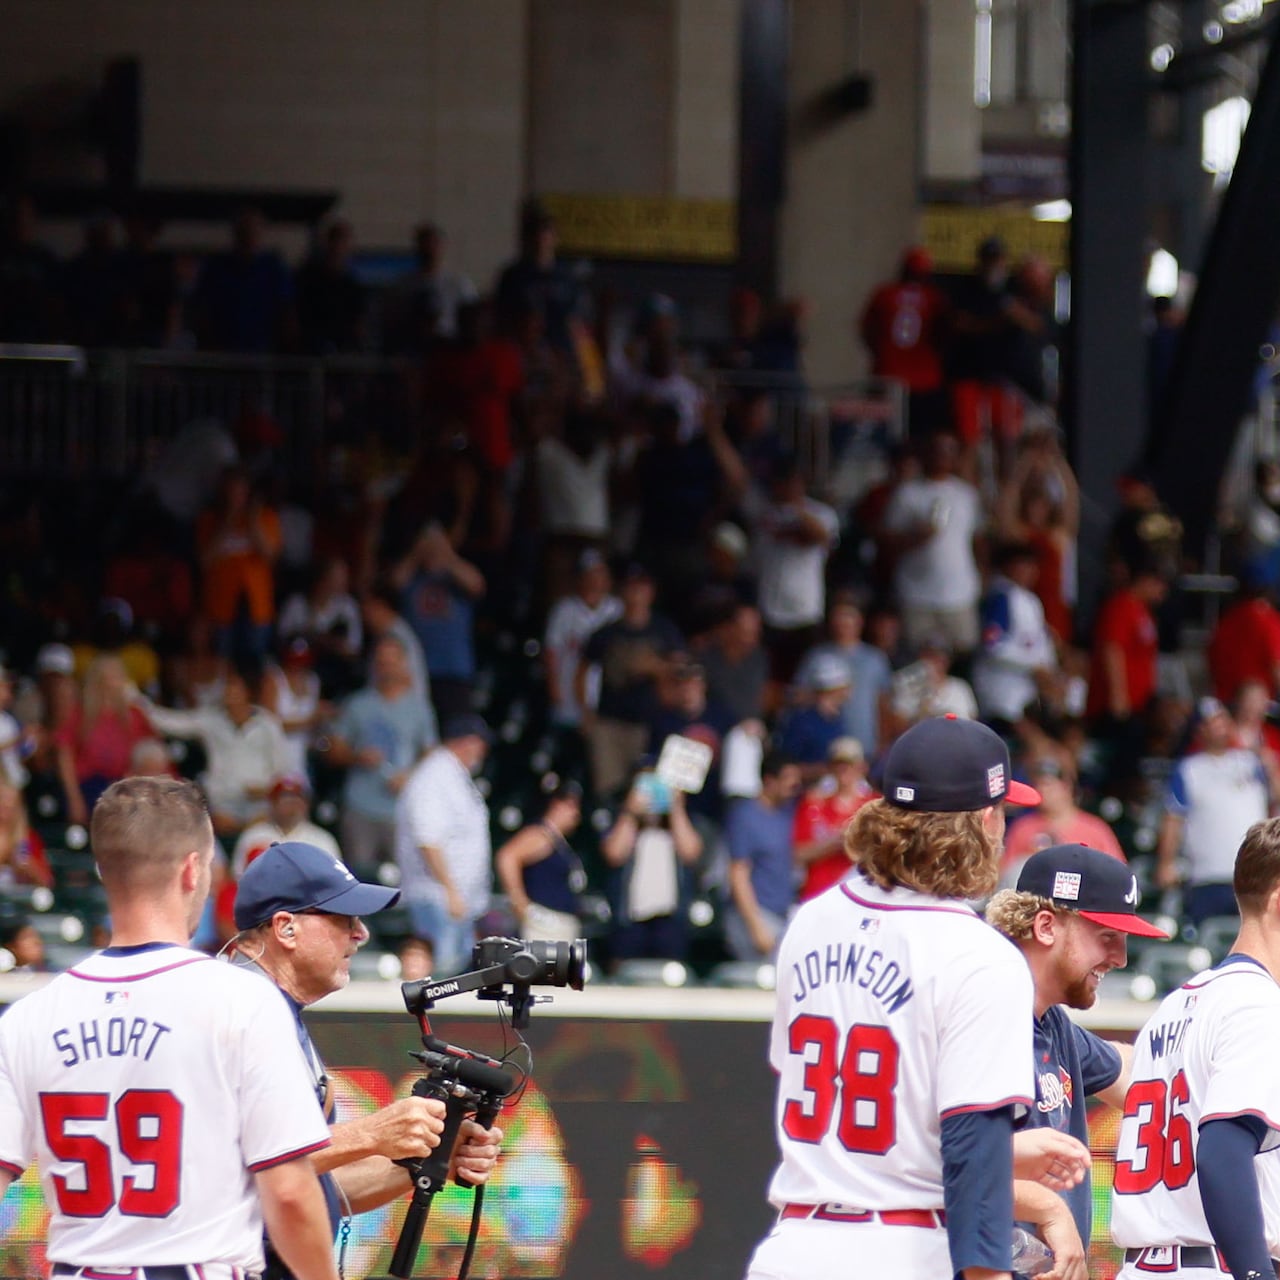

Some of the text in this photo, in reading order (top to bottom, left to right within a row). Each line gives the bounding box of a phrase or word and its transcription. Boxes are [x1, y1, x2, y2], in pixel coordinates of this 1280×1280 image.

[426, 981, 460, 999] RONIN
[793, 943, 915, 1015] JOHNSON
[52, 1017, 172, 1068] SHORT
[782, 1012, 900, 1156] 38
[38, 1088, 184, 1218] 59
[1113, 1068, 1195, 1195] 36
